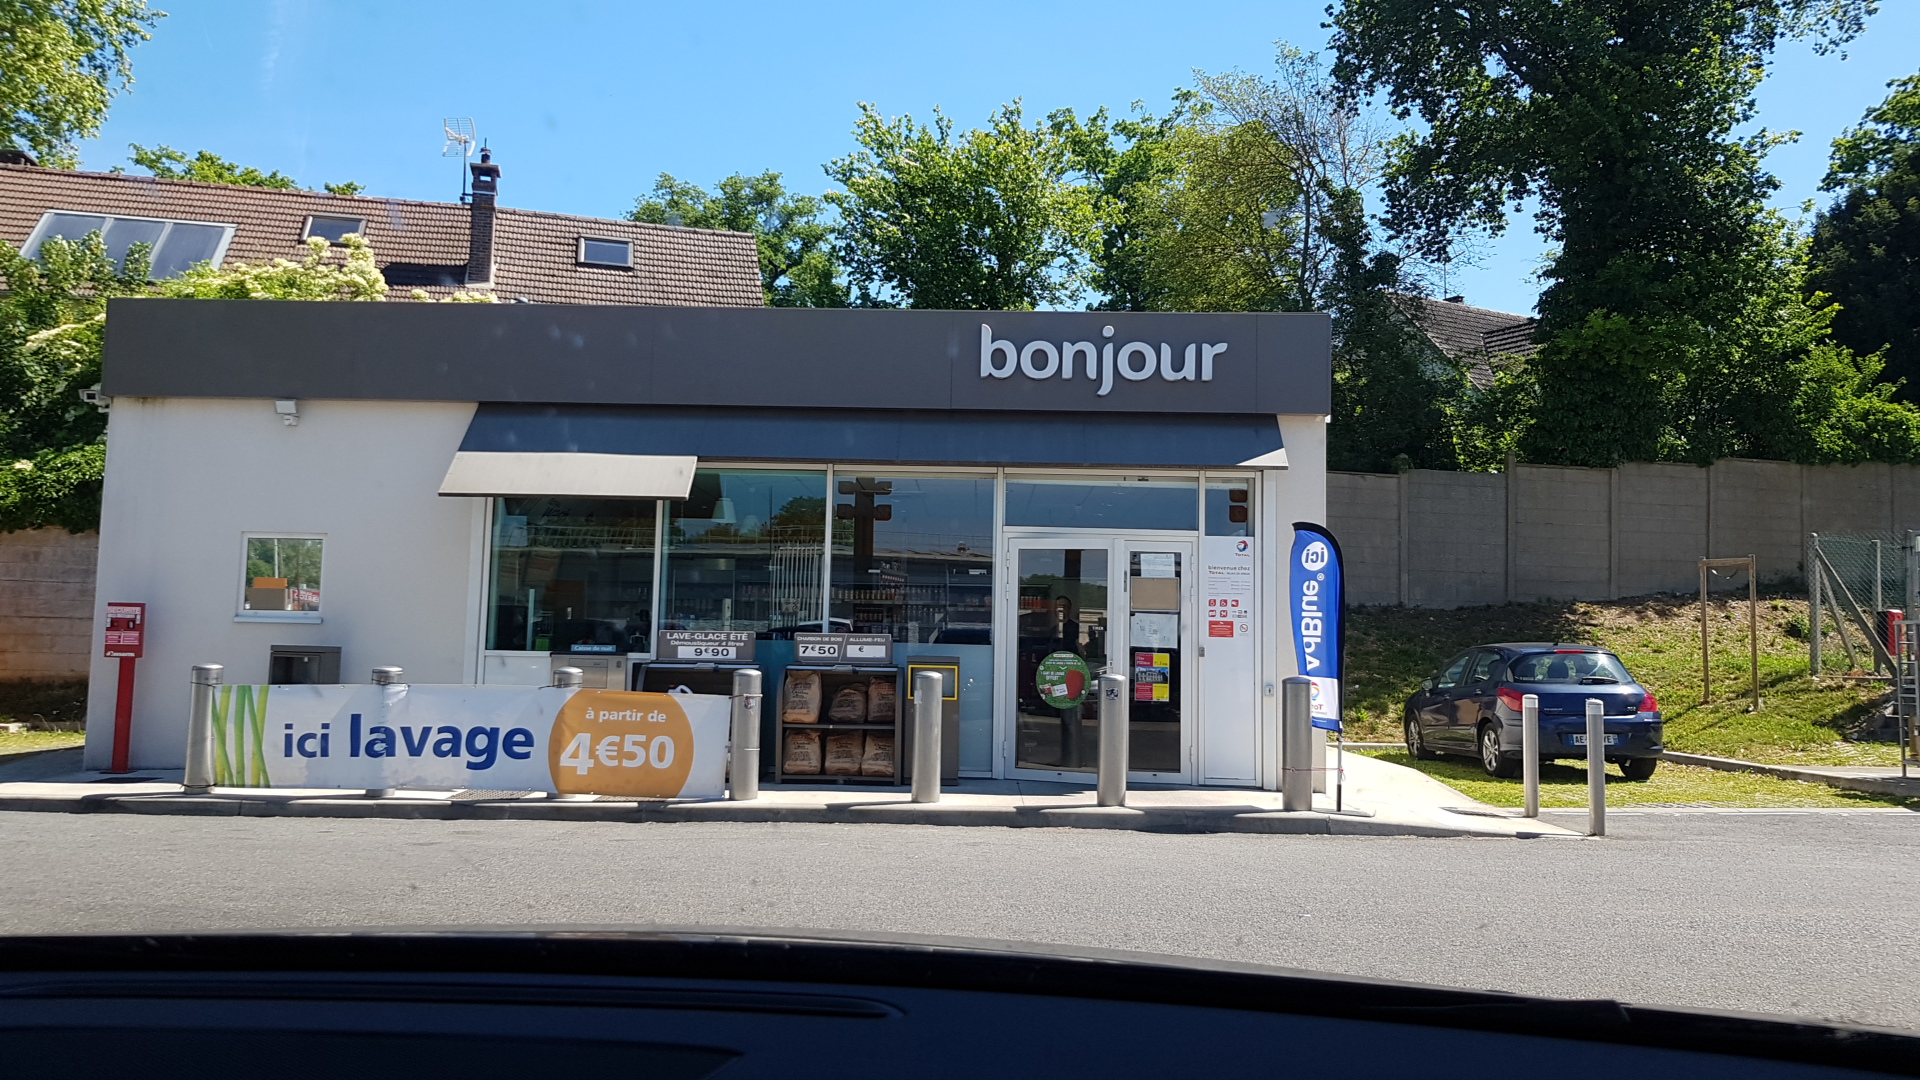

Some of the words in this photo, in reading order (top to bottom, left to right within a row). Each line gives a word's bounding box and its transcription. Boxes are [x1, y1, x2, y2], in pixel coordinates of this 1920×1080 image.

[980, 323, 1228, 396] bonjour
[666, 632, 728, 640] LAVE-GLACE
[730, 632, 749, 641] ÉTÉ
[694, 647, 730, 657] 9€90
[800, 645, 837, 655] 7€50
[585, 707, 595, 719] à
[599, 709, 644, 722] partir
[647, 710, 667, 722] de
[284, 722, 330, 758] ici
[349, 713, 535, 771] lavage
[559, 732, 675, 775] 4€50
